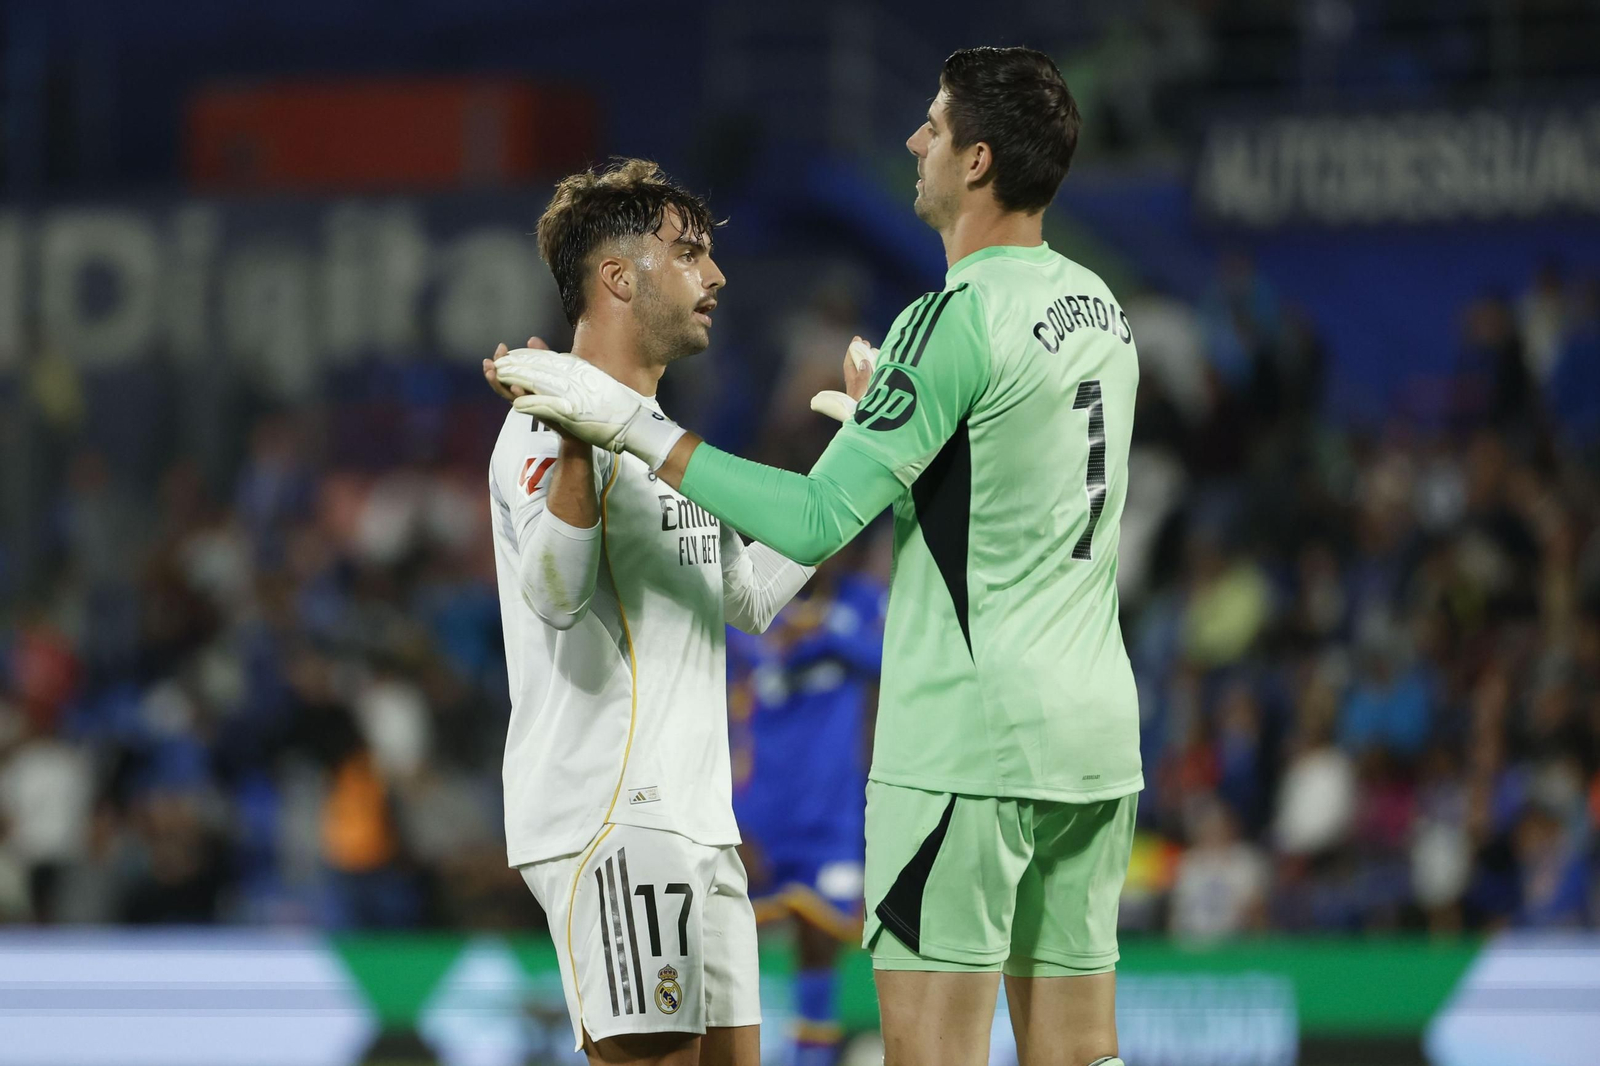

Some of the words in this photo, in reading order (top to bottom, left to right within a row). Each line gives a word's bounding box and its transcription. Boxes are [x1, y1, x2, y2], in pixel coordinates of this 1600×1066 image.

[1032, 294, 1133, 355] COURTOIS
[1070, 378, 1108, 561] 1
[679, 535, 698, 566] FLY
[702, 534, 718, 564] BET
[633, 883, 694, 957] 17
